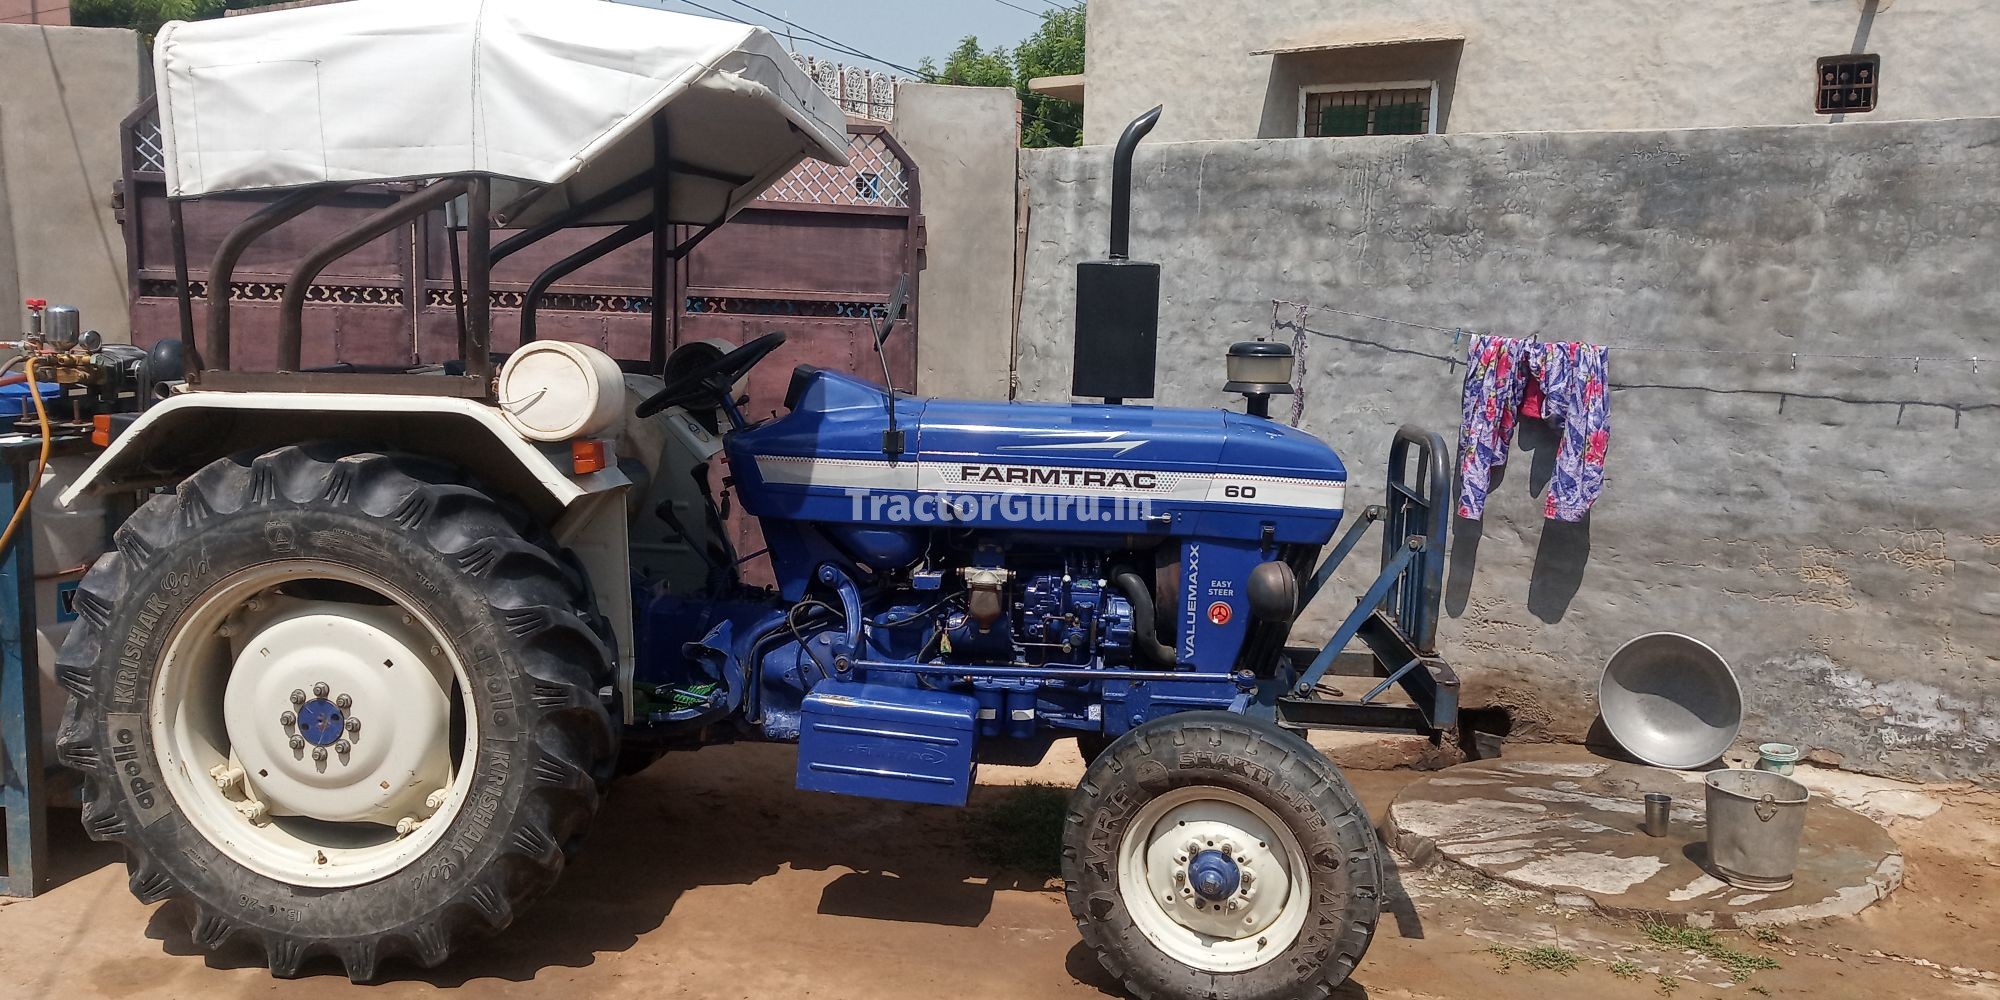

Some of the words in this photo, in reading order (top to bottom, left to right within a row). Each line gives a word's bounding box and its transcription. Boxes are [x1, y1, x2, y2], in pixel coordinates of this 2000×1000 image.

[960, 465, 1157, 490] FARMTRAC
[1224, 485, 1257, 499] 60
[1184, 544, 1200, 659] VALUEMAXX
[1208, 588, 1234, 597] STEER
[1211, 580, 1232, 588] EASY
[113, 593, 170, 705] KRISHAK
[161, 548, 211, 596] Gold
[112, 728, 155, 810] apollo
[453, 752, 512, 861] KRISHAK
[1179, 751, 1275, 787] SHAKTI
[1276, 780, 1328, 833] LIFE
